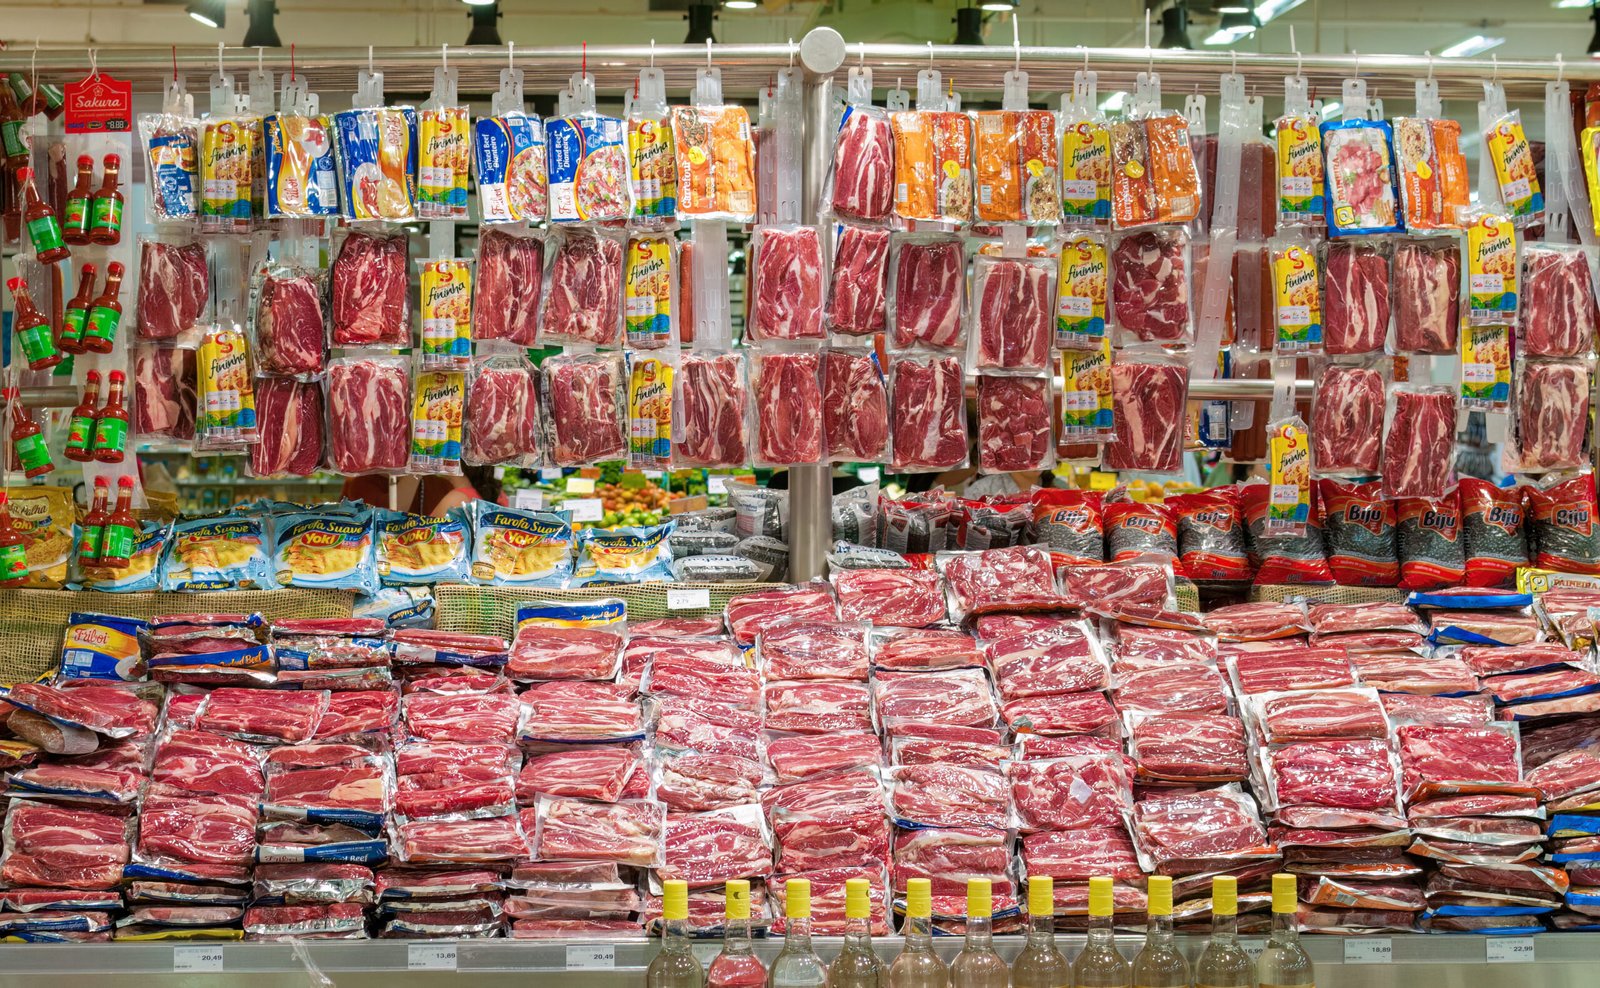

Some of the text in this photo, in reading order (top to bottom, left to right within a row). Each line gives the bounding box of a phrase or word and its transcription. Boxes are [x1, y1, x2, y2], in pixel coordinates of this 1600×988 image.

[75, 95, 121, 108] Sakura
[426, 133, 464, 155] fininha
[481, 133, 490, 148] Beef
[554, 131, 563, 148] Beef
[1040, 115, 1050, 162] Carrefour
[632, 141, 668, 168] fininha
[1069, 144, 1106, 168] fininha
[1286, 141, 1319, 165] fininha
[1503, 140, 1527, 172] fininha
[681, 161, 692, 209] Carrefour
[1412, 175, 1421, 224] Carrefour
[1476, 242, 1512, 262] fininha
[628, 258, 664, 285] fininha
[1065, 262, 1104, 284] fininha
[1283, 270, 1315, 295] fininha
[426, 281, 465, 307] fininha
[208, 352, 246, 379] fininha
[1069, 353, 1106, 379] fininha
[419, 385, 459, 407] fininha
[633, 382, 666, 406] fininha
[1278, 448, 1307, 473] fininha
[21, 503, 47, 516] Palha
[1196, 509, 1228, 523] Biju
[1349, 505, 1381, 523] Biju
[1423, 510, 1455, 529] Biju
[1489, 506, 1519, 527] Biju
[1556, 508, 1588, 528] Biju
[214, 525, 249, 534] Suave
[293, 520, 363, 535] Farofa Suave
[386, 517, 417, 532] Farofa
[494, 514, 530, 530] Farofa
[629, 533, 662, 547] Suave
[74, 627, 109, 645] Friboi
[244, 650, 263, 664] Beef
